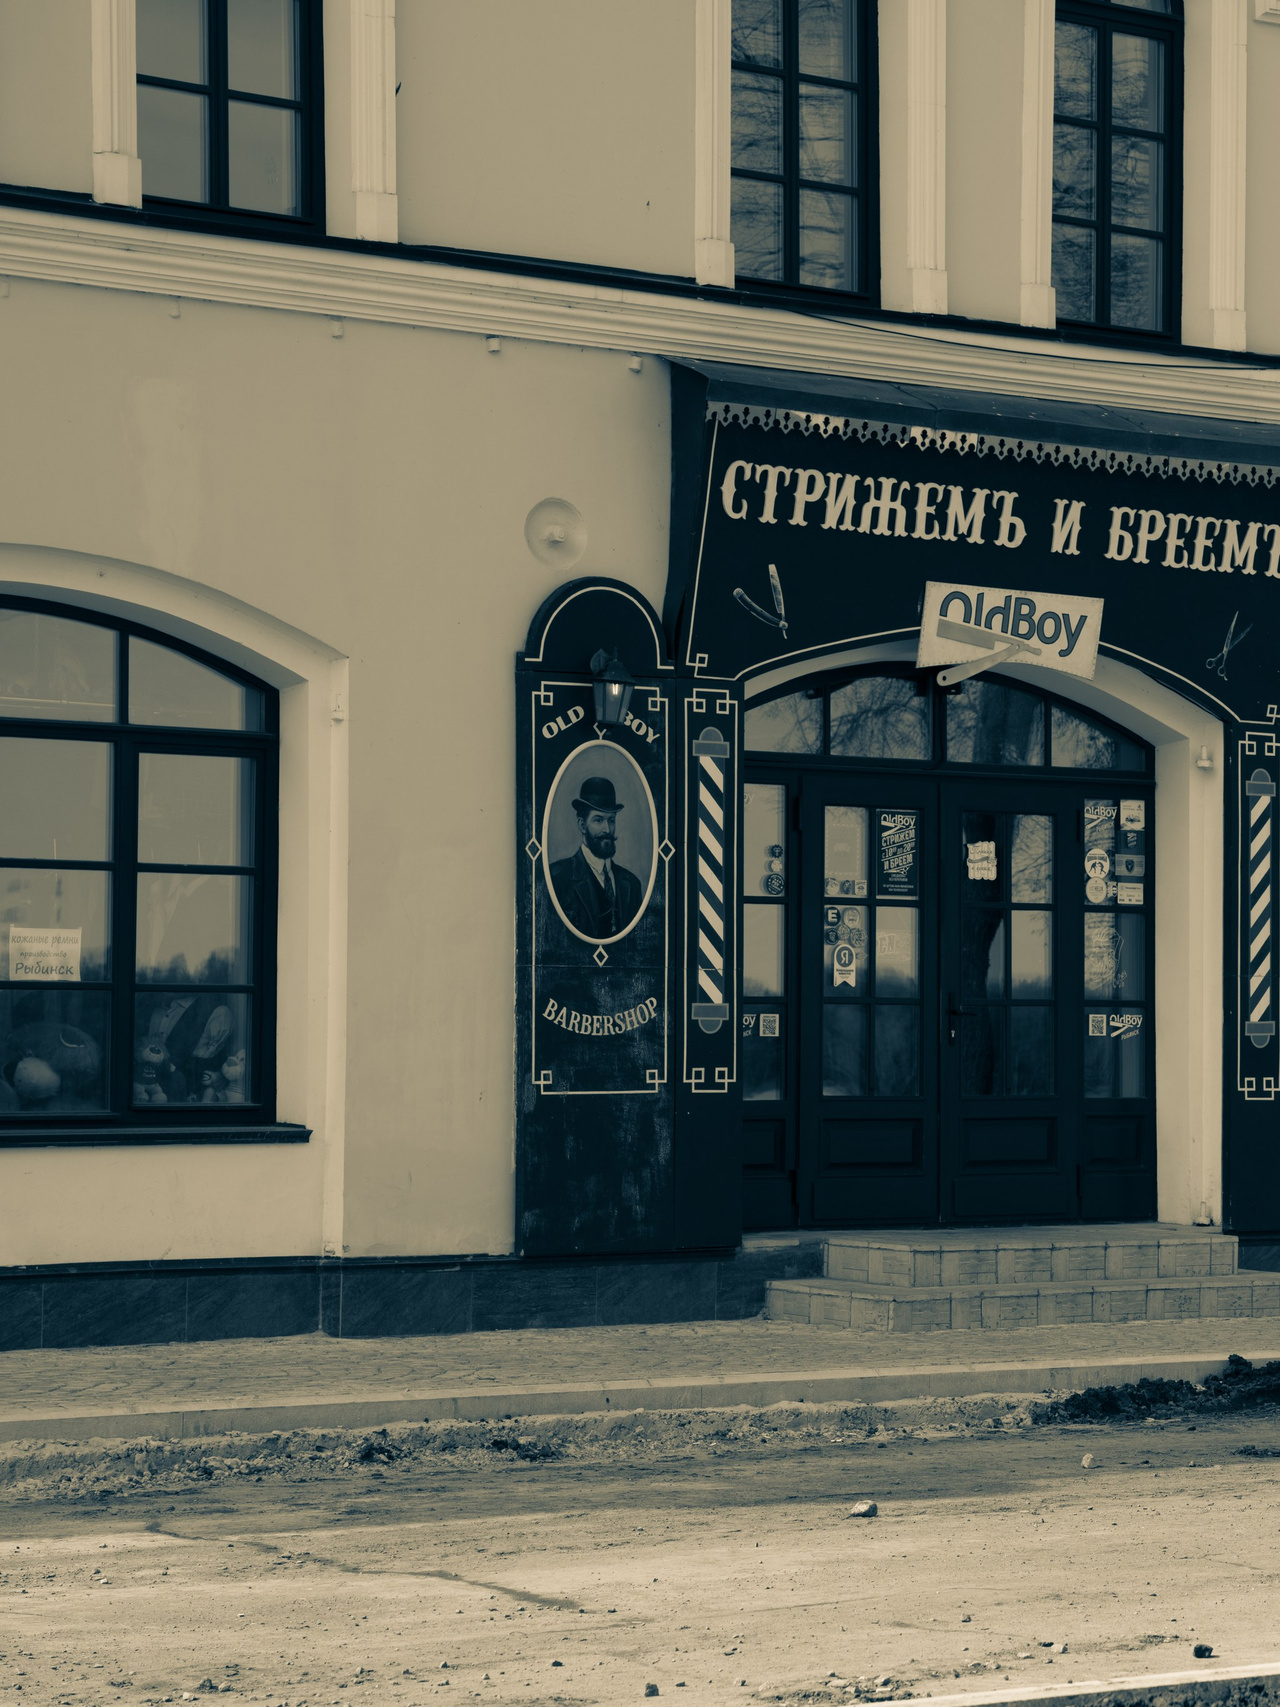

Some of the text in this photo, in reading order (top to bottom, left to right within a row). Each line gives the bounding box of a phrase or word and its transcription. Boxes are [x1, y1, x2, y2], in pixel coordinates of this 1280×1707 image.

[720, 460, 1027, 549] СТРИЖЕМЪ
[1051, 497, 1085, 556] И
[938, 591, 1088, 658] OldBoy
[542, 706, 585, 739] OLD
[881, 829, 915, 847] СТРИЖЕМ
[884, 853, 913, 870] И БРЕЕМ
[11, 935, 79, 948] кожаные ремни
[15, 960, 74, 975] Рыбинск
[542, 997, 658, 1036] BARBERSHOP
